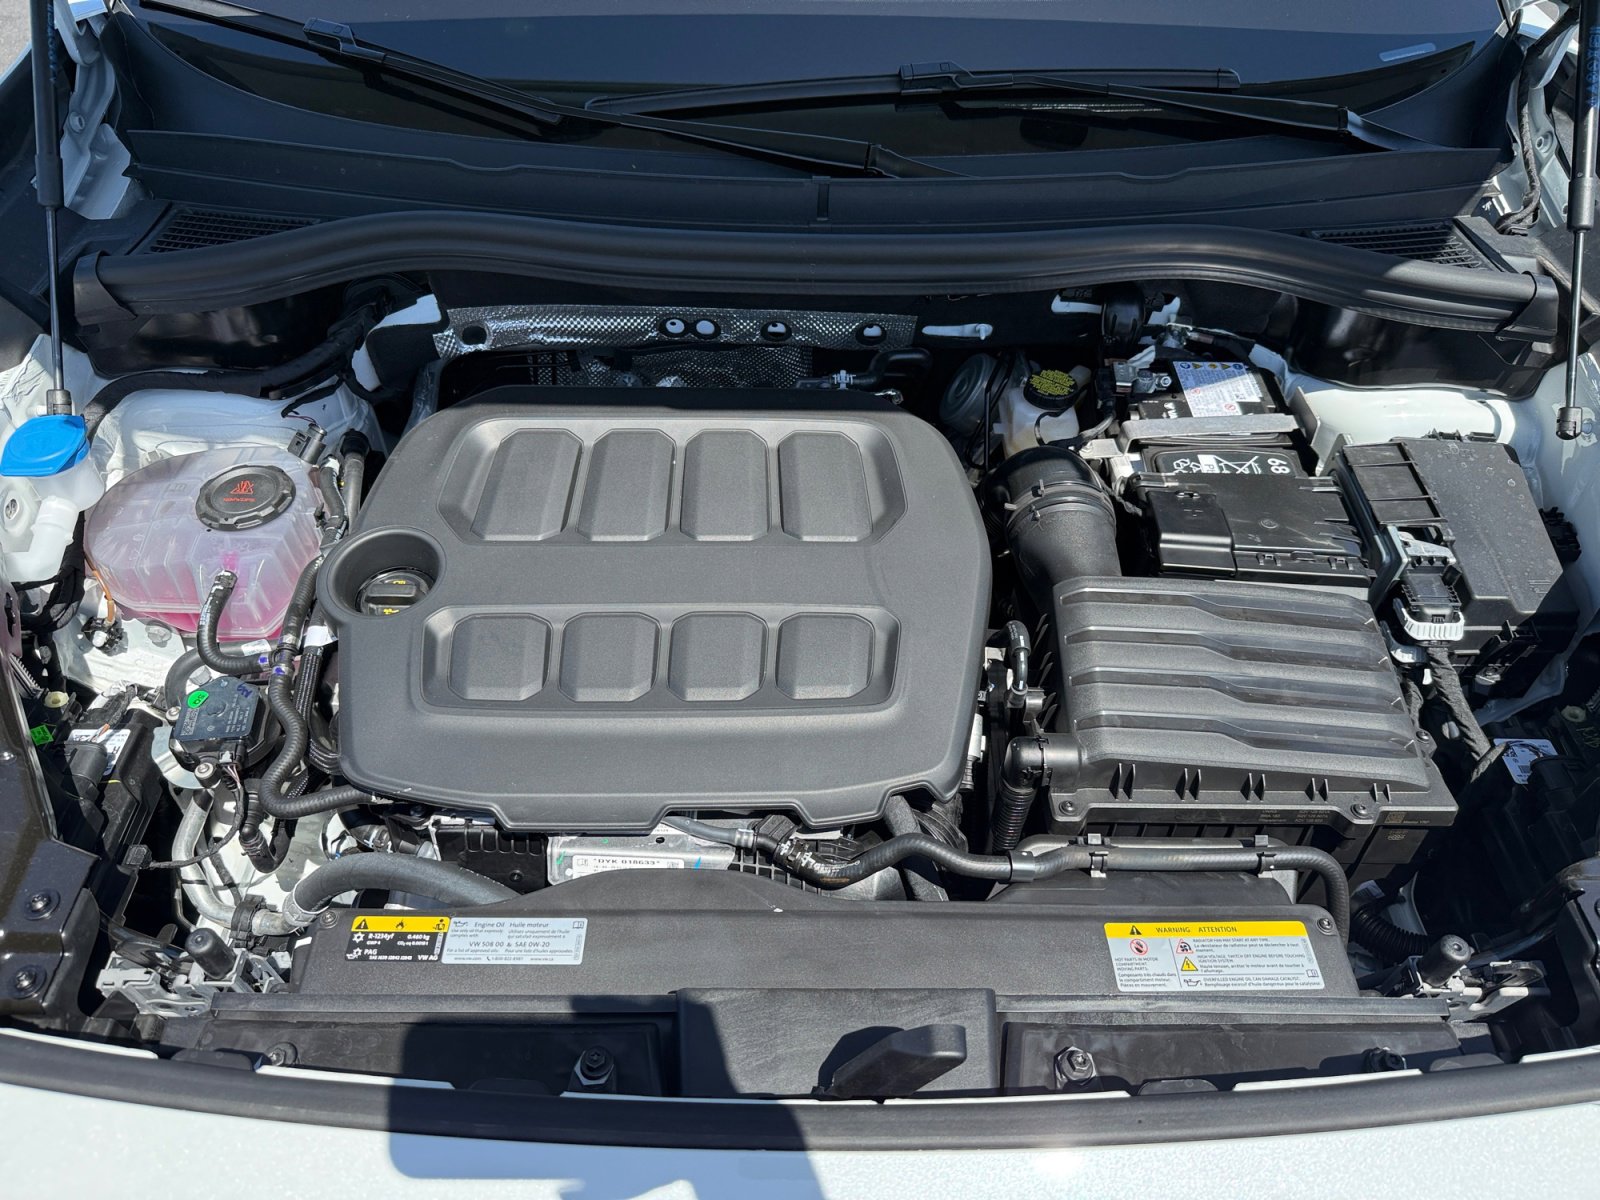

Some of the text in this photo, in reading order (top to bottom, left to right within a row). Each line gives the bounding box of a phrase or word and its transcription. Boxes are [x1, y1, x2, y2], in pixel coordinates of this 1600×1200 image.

[1267, 457, 1292, 475] 68
[474, 921, 495, 929] Engine
[368, 933, 395, 941] R-1234yf
